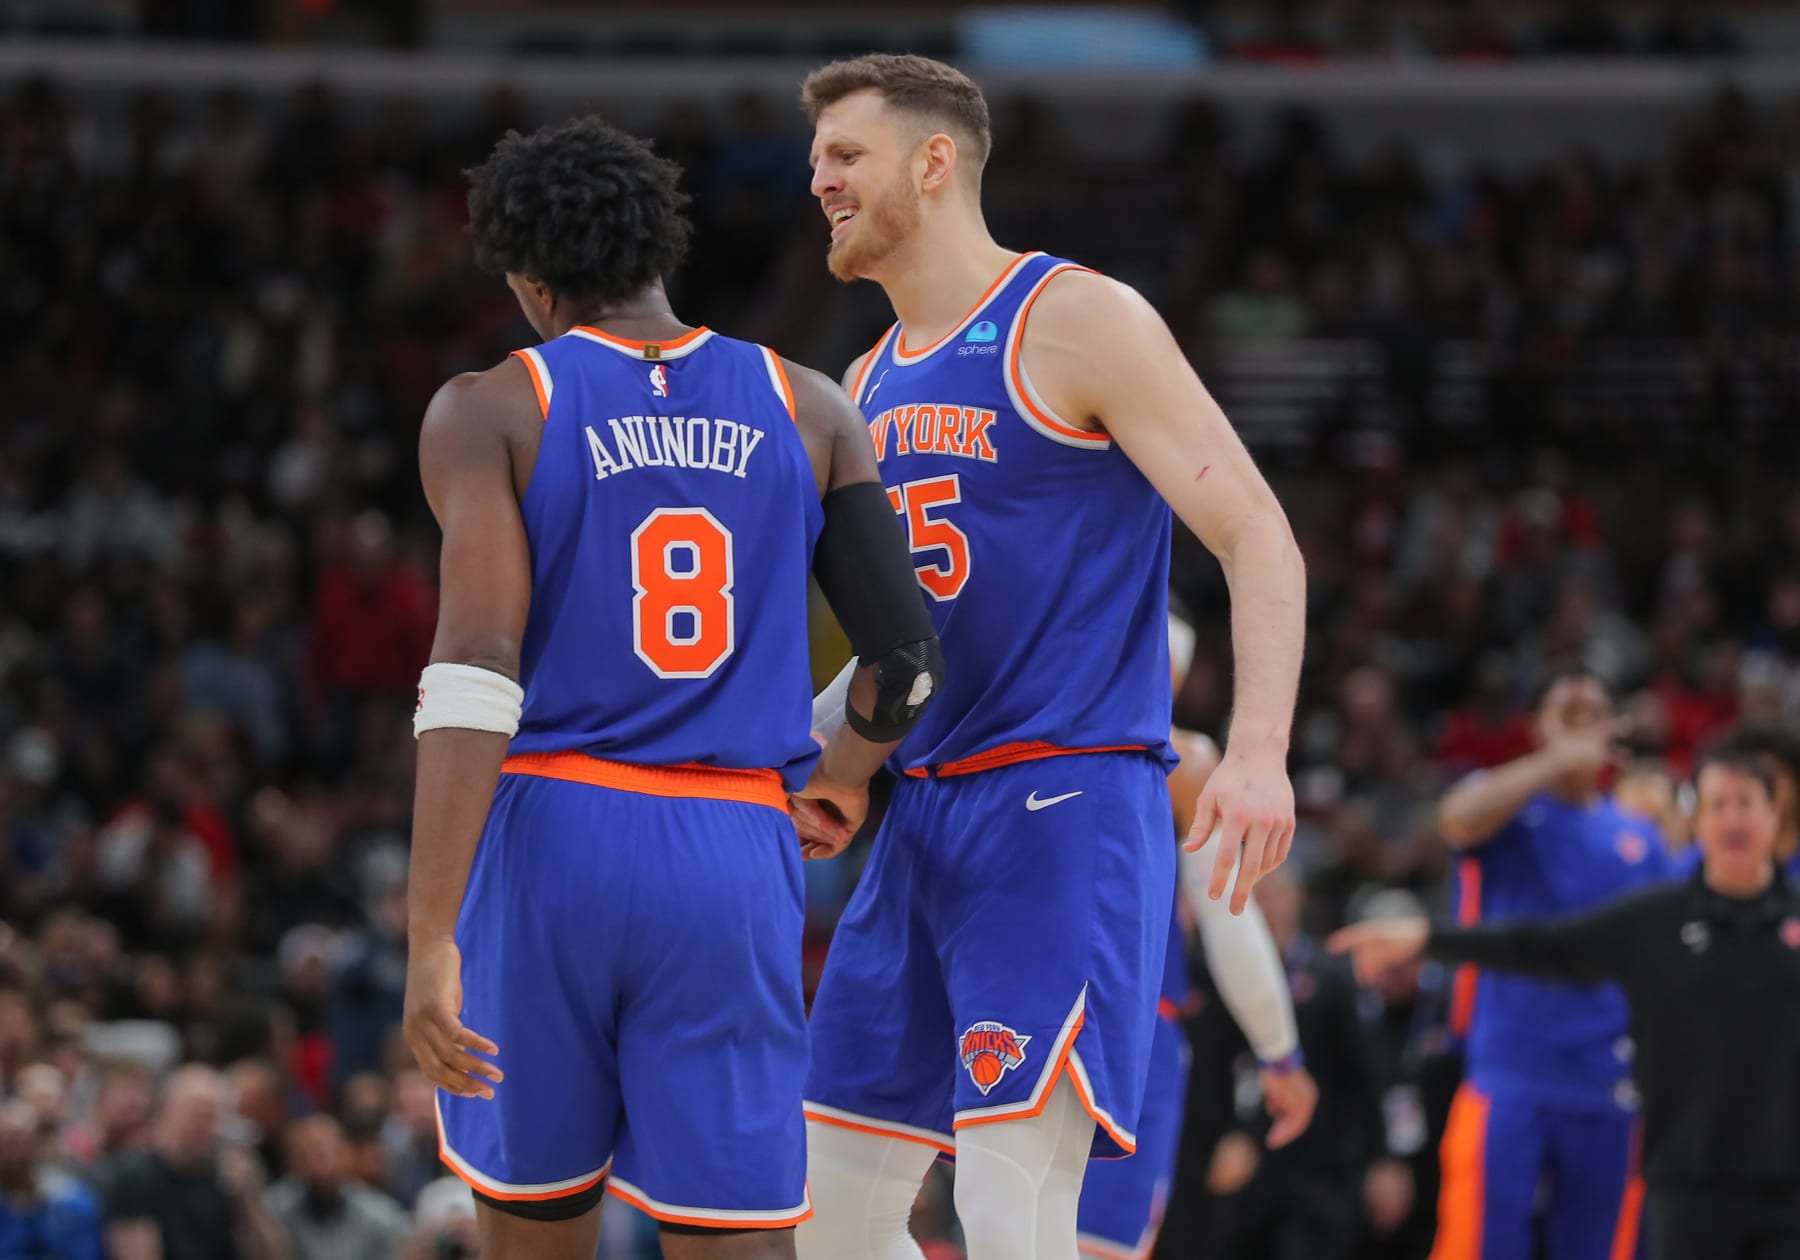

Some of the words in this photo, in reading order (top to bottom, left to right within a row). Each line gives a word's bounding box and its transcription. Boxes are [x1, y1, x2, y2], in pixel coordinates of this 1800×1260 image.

[957, 344, 998, 357] sphere
[585, 416, 765, 480] ANUNOBY
[893, 402, 998, 463] YORK
[630, 507, 735, 679] 8
[961, 1029, 1022, 1059] KNICKS
